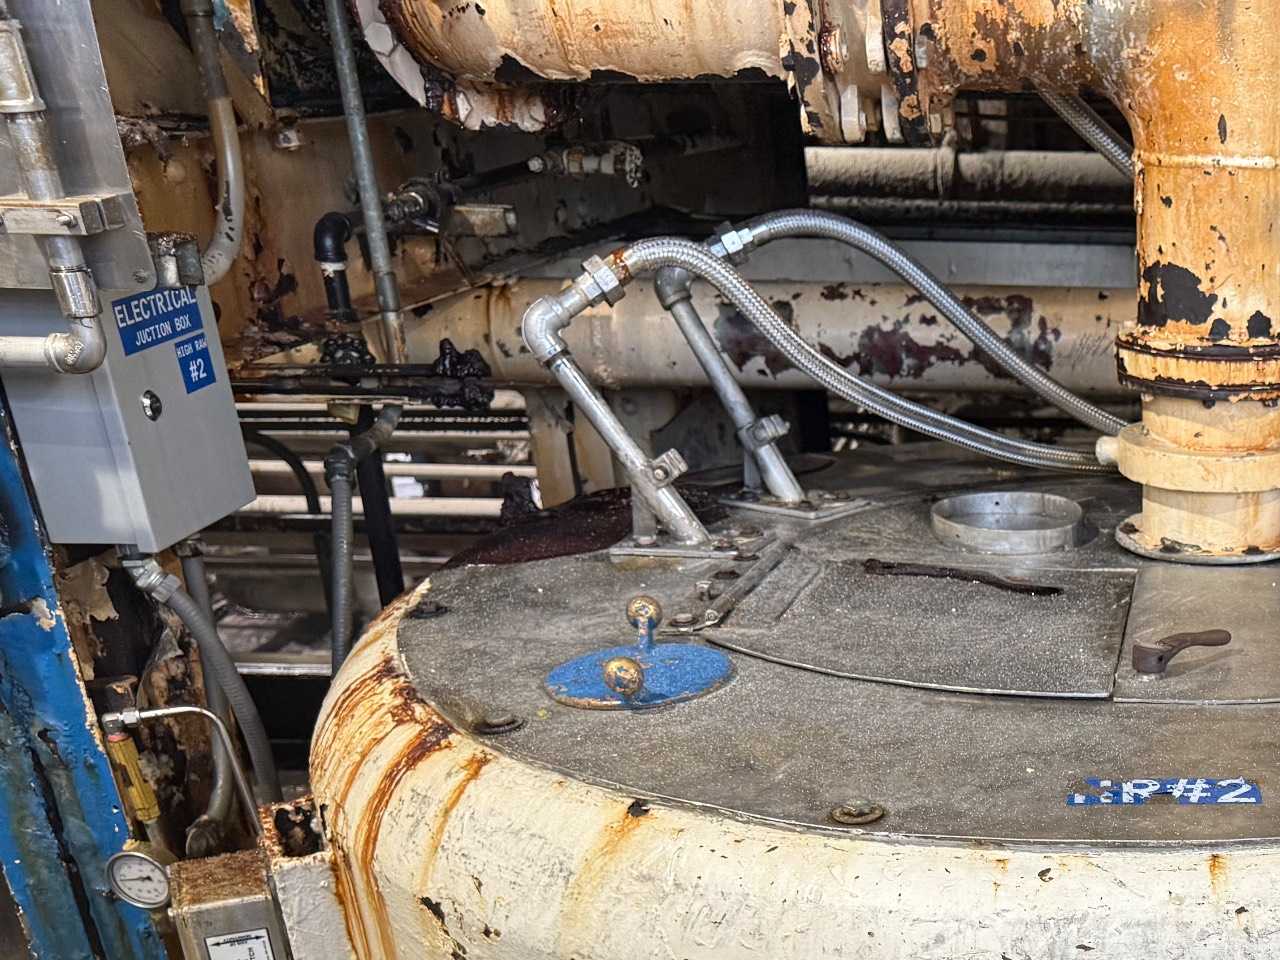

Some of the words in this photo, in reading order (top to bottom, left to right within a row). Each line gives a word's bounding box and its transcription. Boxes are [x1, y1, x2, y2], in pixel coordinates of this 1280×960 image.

[114, 286, 196, 328] ELECTRICAL
[135, 320, 172, 346] JUCTION
[174, 314, 191, 331] BOX
[176, 343, 193, 358] HIGH
[189, 358, 207, 382] #2
